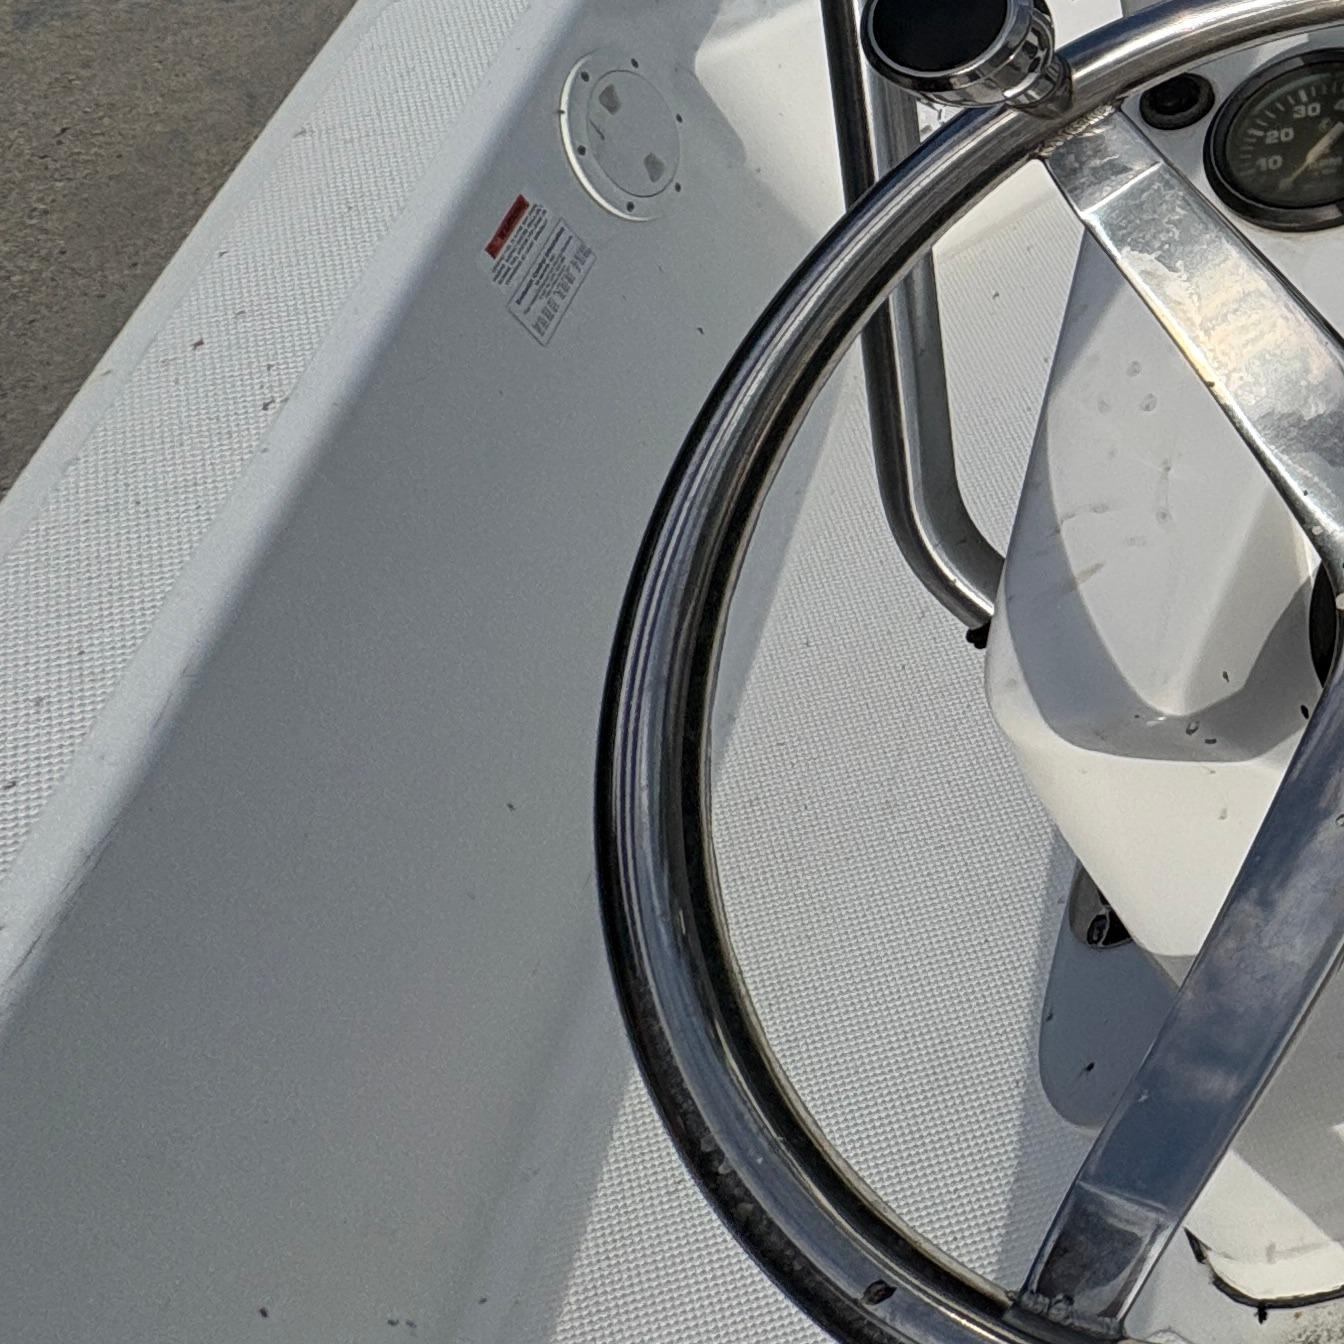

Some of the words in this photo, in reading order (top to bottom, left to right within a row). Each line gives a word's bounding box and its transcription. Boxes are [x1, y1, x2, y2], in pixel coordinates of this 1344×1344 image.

[1292, 102, 1321, 119] 30
[1265, 127, 1295, 145] 20
[1255, 154, 1284, 172] 10
